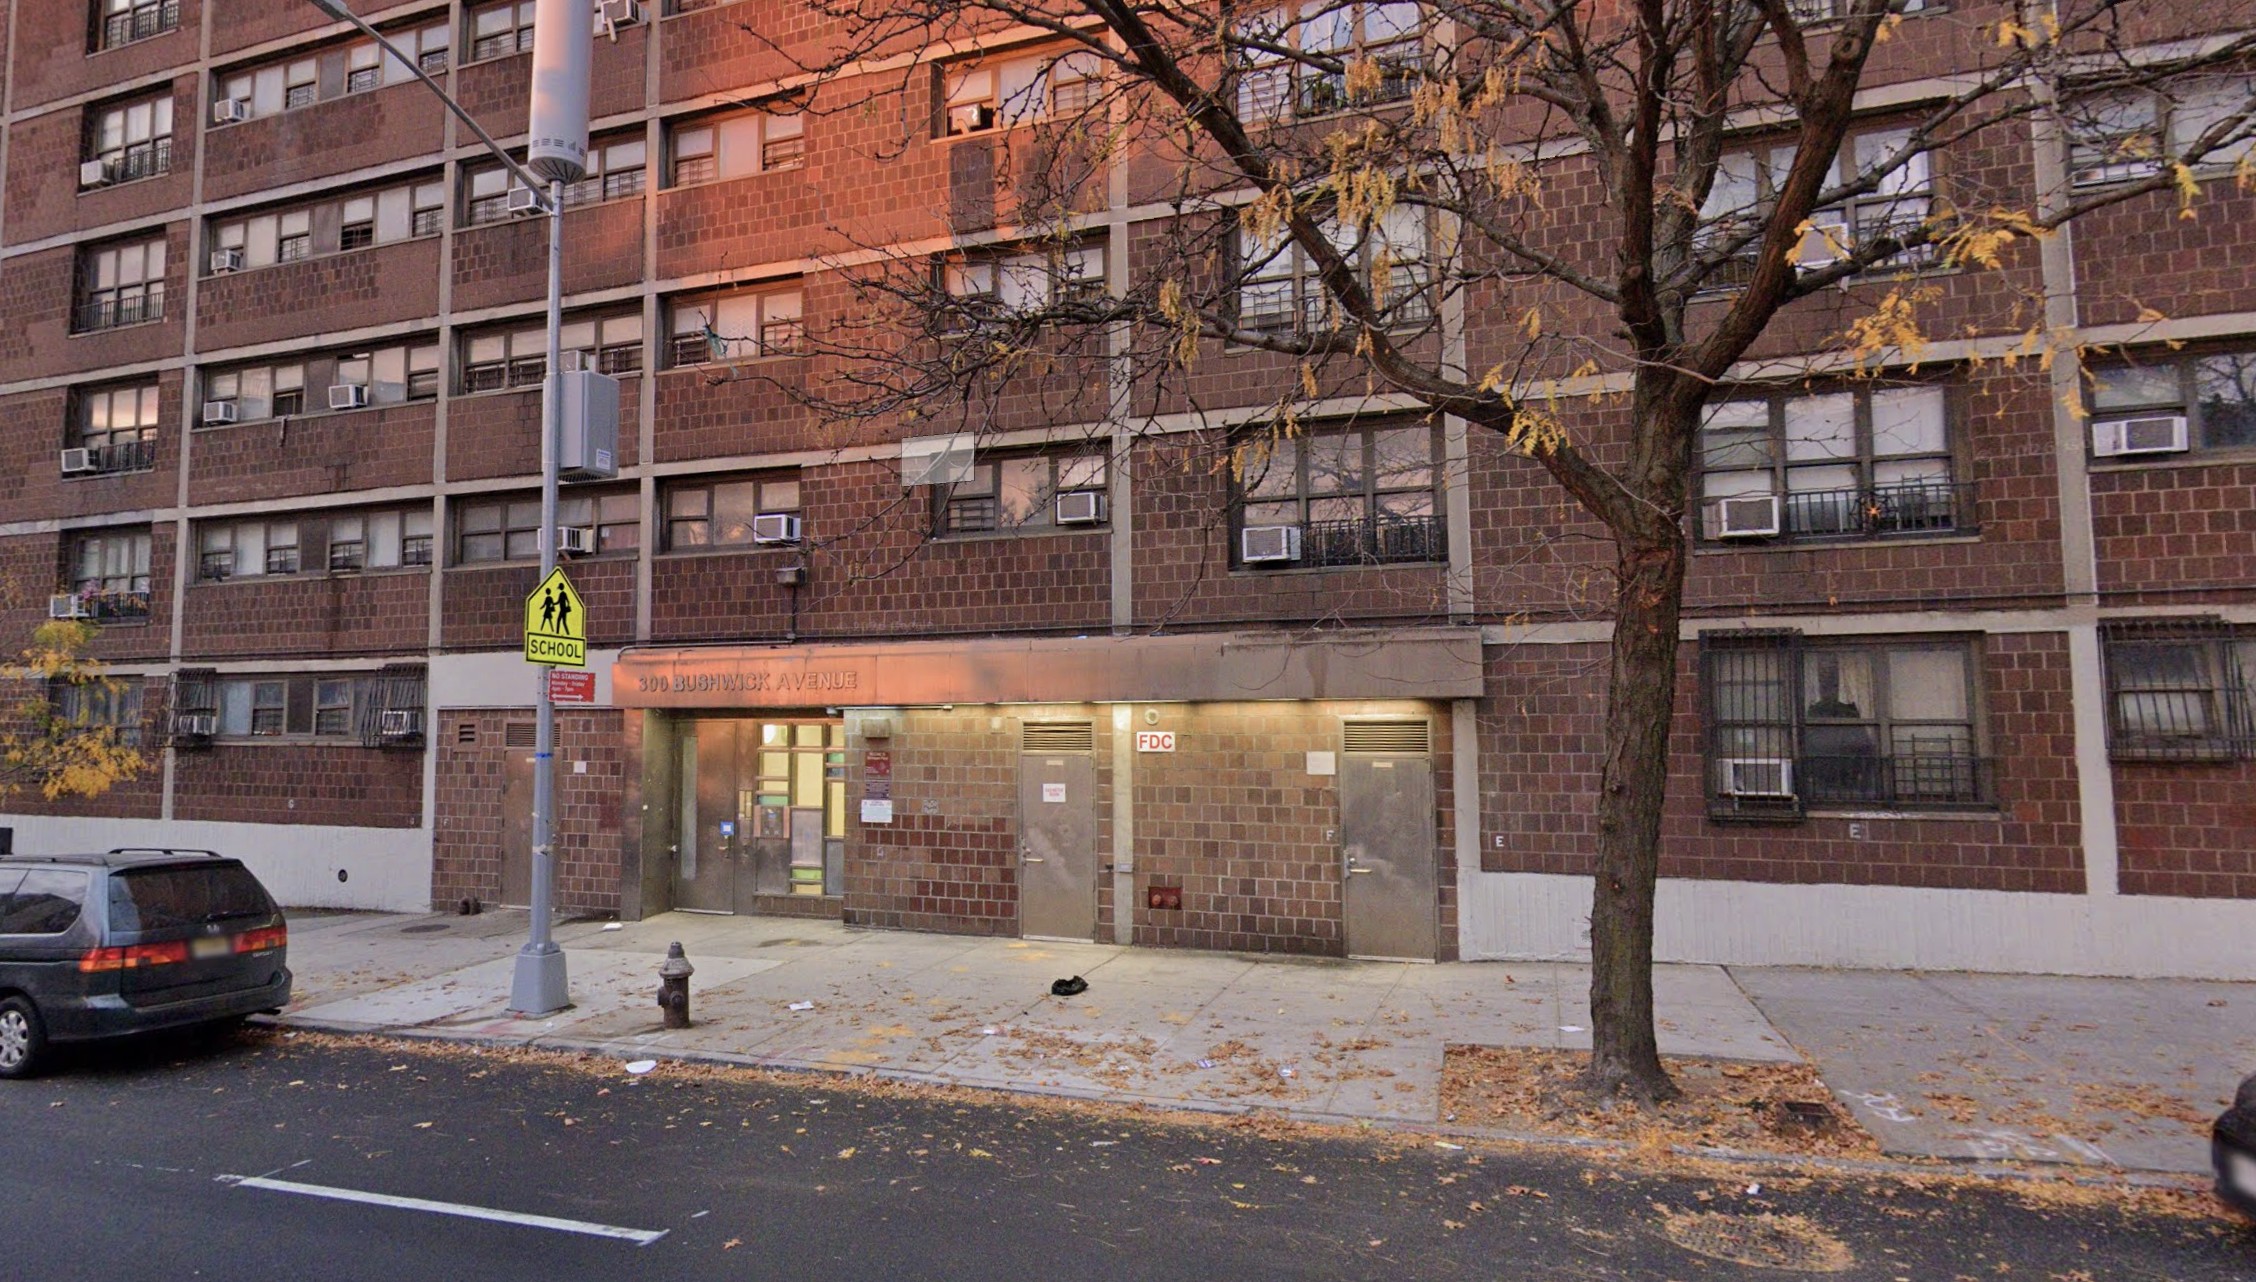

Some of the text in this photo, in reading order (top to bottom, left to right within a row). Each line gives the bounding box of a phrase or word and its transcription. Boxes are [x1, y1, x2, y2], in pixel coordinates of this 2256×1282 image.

[530, 639, 582, 659] SCHOOL
[561, 673, 589, 681] STANDING
[639, 671, 858, 692] 300 BUSHWICK AVENUE
[1139, 734, 1173, 749] FDC
[1326, 829, 1335, 841] F
[1849, 823, 1861, 839] E
[1495, 835, 1505, 847] E
